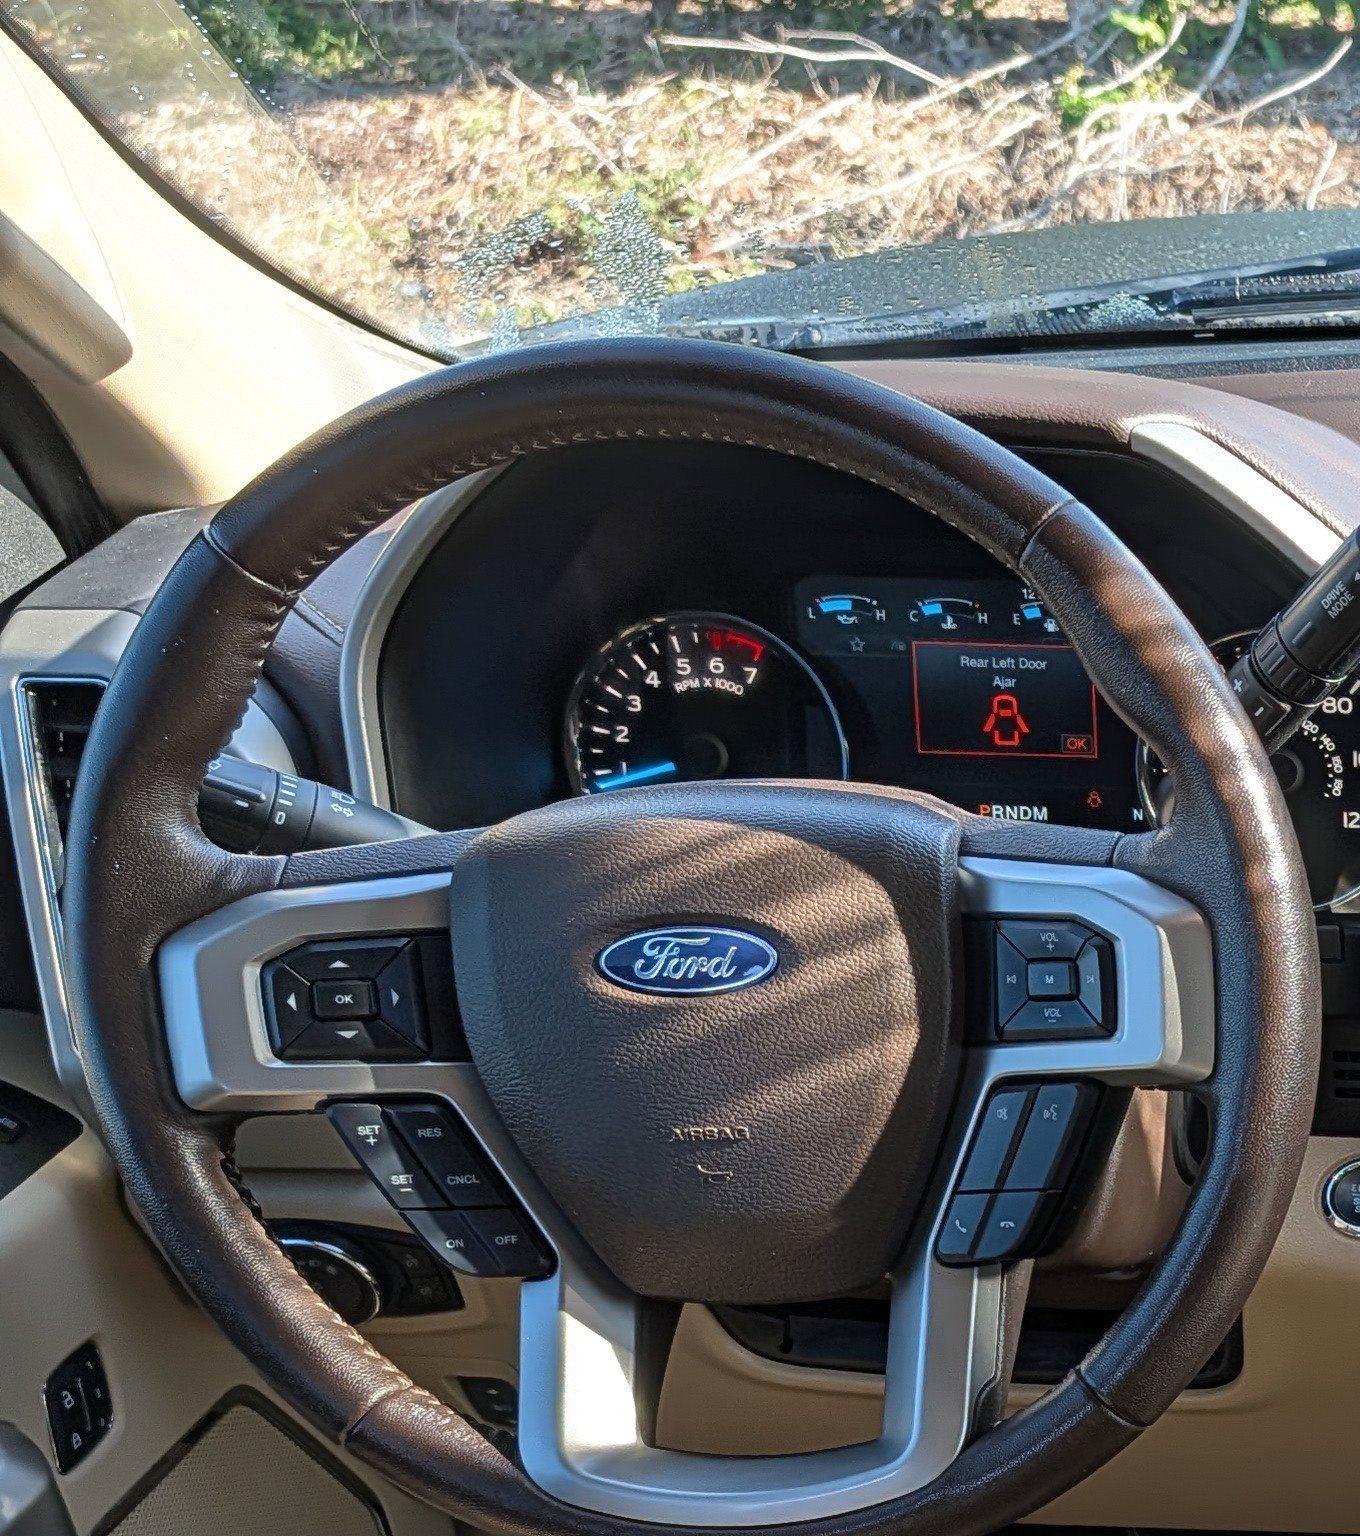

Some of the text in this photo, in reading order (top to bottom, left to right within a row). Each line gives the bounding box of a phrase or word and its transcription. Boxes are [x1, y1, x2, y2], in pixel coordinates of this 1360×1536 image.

[1320, 580, 1348, 610] DRIVE
[1328, 592, 1356, 620] MODE
[807, 607, 816, 619] L
[875, 609, 886, 621] H
[909, 610, 919, 622] C
[977, 612, 988, 624] H
[1012, 613, 1021, 626] E
[676, 658, 692, 676] 5
[709, 657, 725, 674] 6
[960, 655, 1048, 671] Rear Left Door
[644, 670, 661, 688] 4
[742, 666, 758, 685] 7
[674, 677, 745, 697] RPM X 1000
[992, 676, 1017, 689] Ajar
[626, 695, 642, 712] 3
[1322, 696, 1353, 714] 80
[1301, 719, 1319, 734] 120
[615, 726, 630, 743] 2
[1066, 737, 1087, 750] OK
[1319, 734, 1336, 751] 140
[1332, 778, 1344, 797] 180
[1132, 808, 1144, 821] N
[1040, 932, 1059, 942] VOL
[632, 936, 738, 981] Ford
[1045, 974, 1054, 984] M
[334, 993, 355, 1004] OK
[1044, 1008, 1062, 1017] VOL
[356, 1125, 380, 1138] SET
[417, 1127, 442, 1139] RES
[670, 1126, 750, 1141] AIRBAG
[390, 1174, 414, 1186] SET
[446, 1174, 480, 1186] CNCL
[445, 1238, 464, 1249] ON
[494, 1234, 519, 1246] OFF
